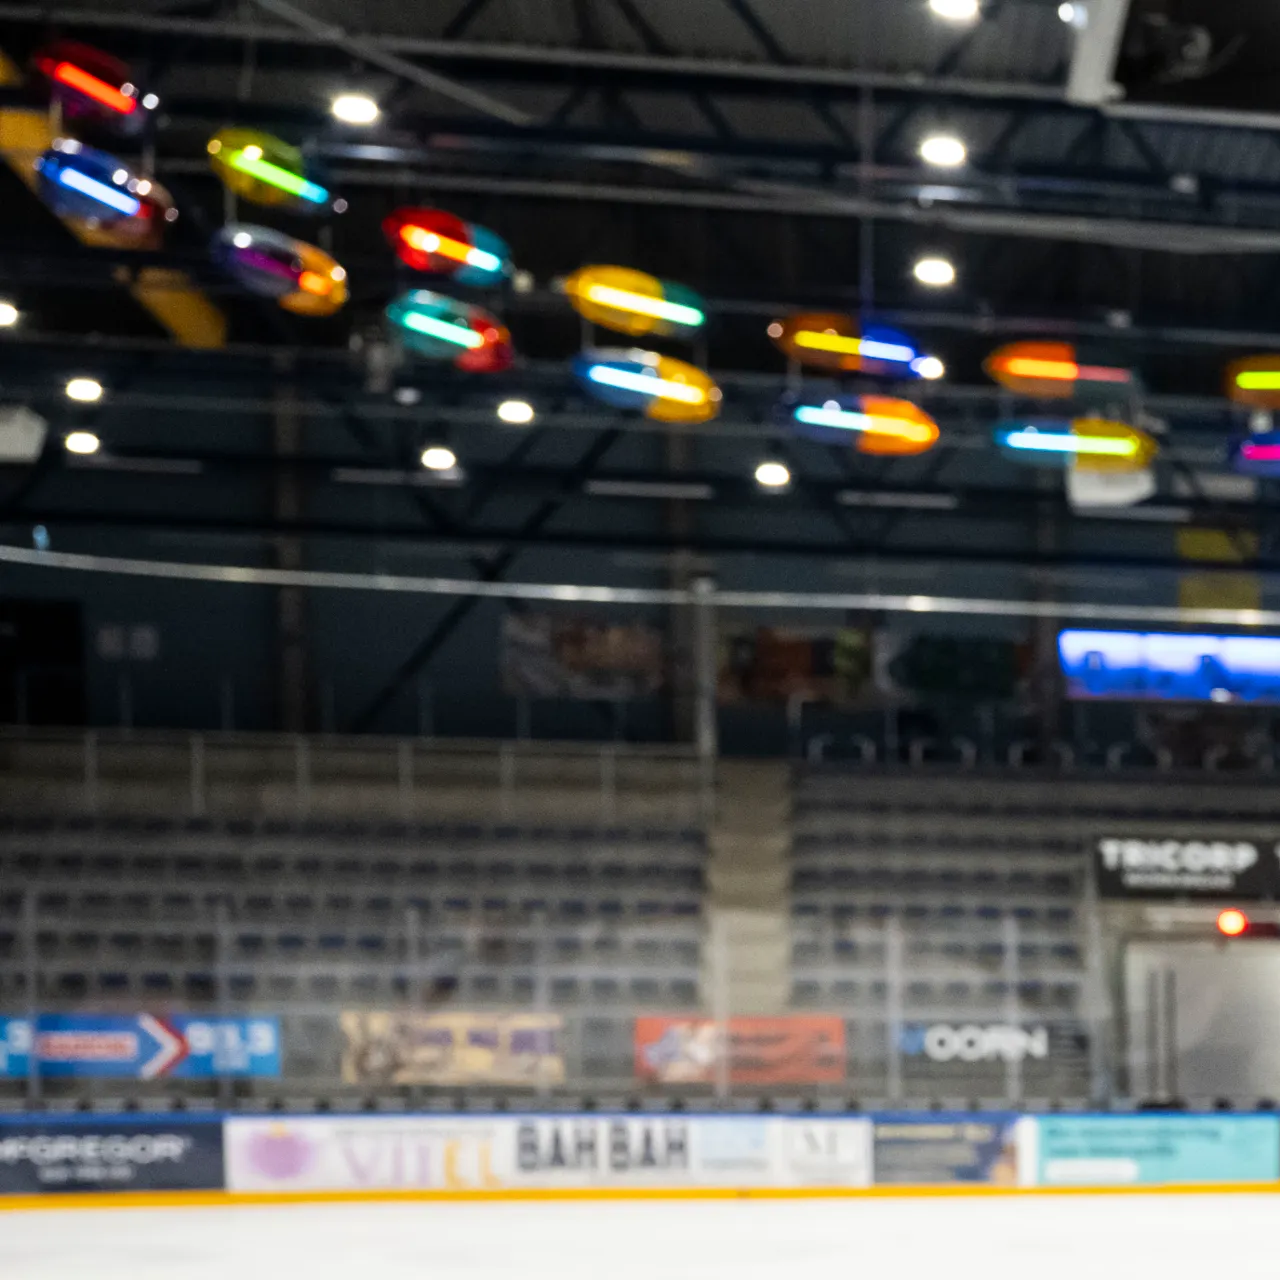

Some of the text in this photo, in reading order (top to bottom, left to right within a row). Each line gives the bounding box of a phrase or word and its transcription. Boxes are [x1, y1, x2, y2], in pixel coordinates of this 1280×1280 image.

[1100, 839, 1258, 873] TRICORP
[516, 1118, 688, 1171] BAH BAH
